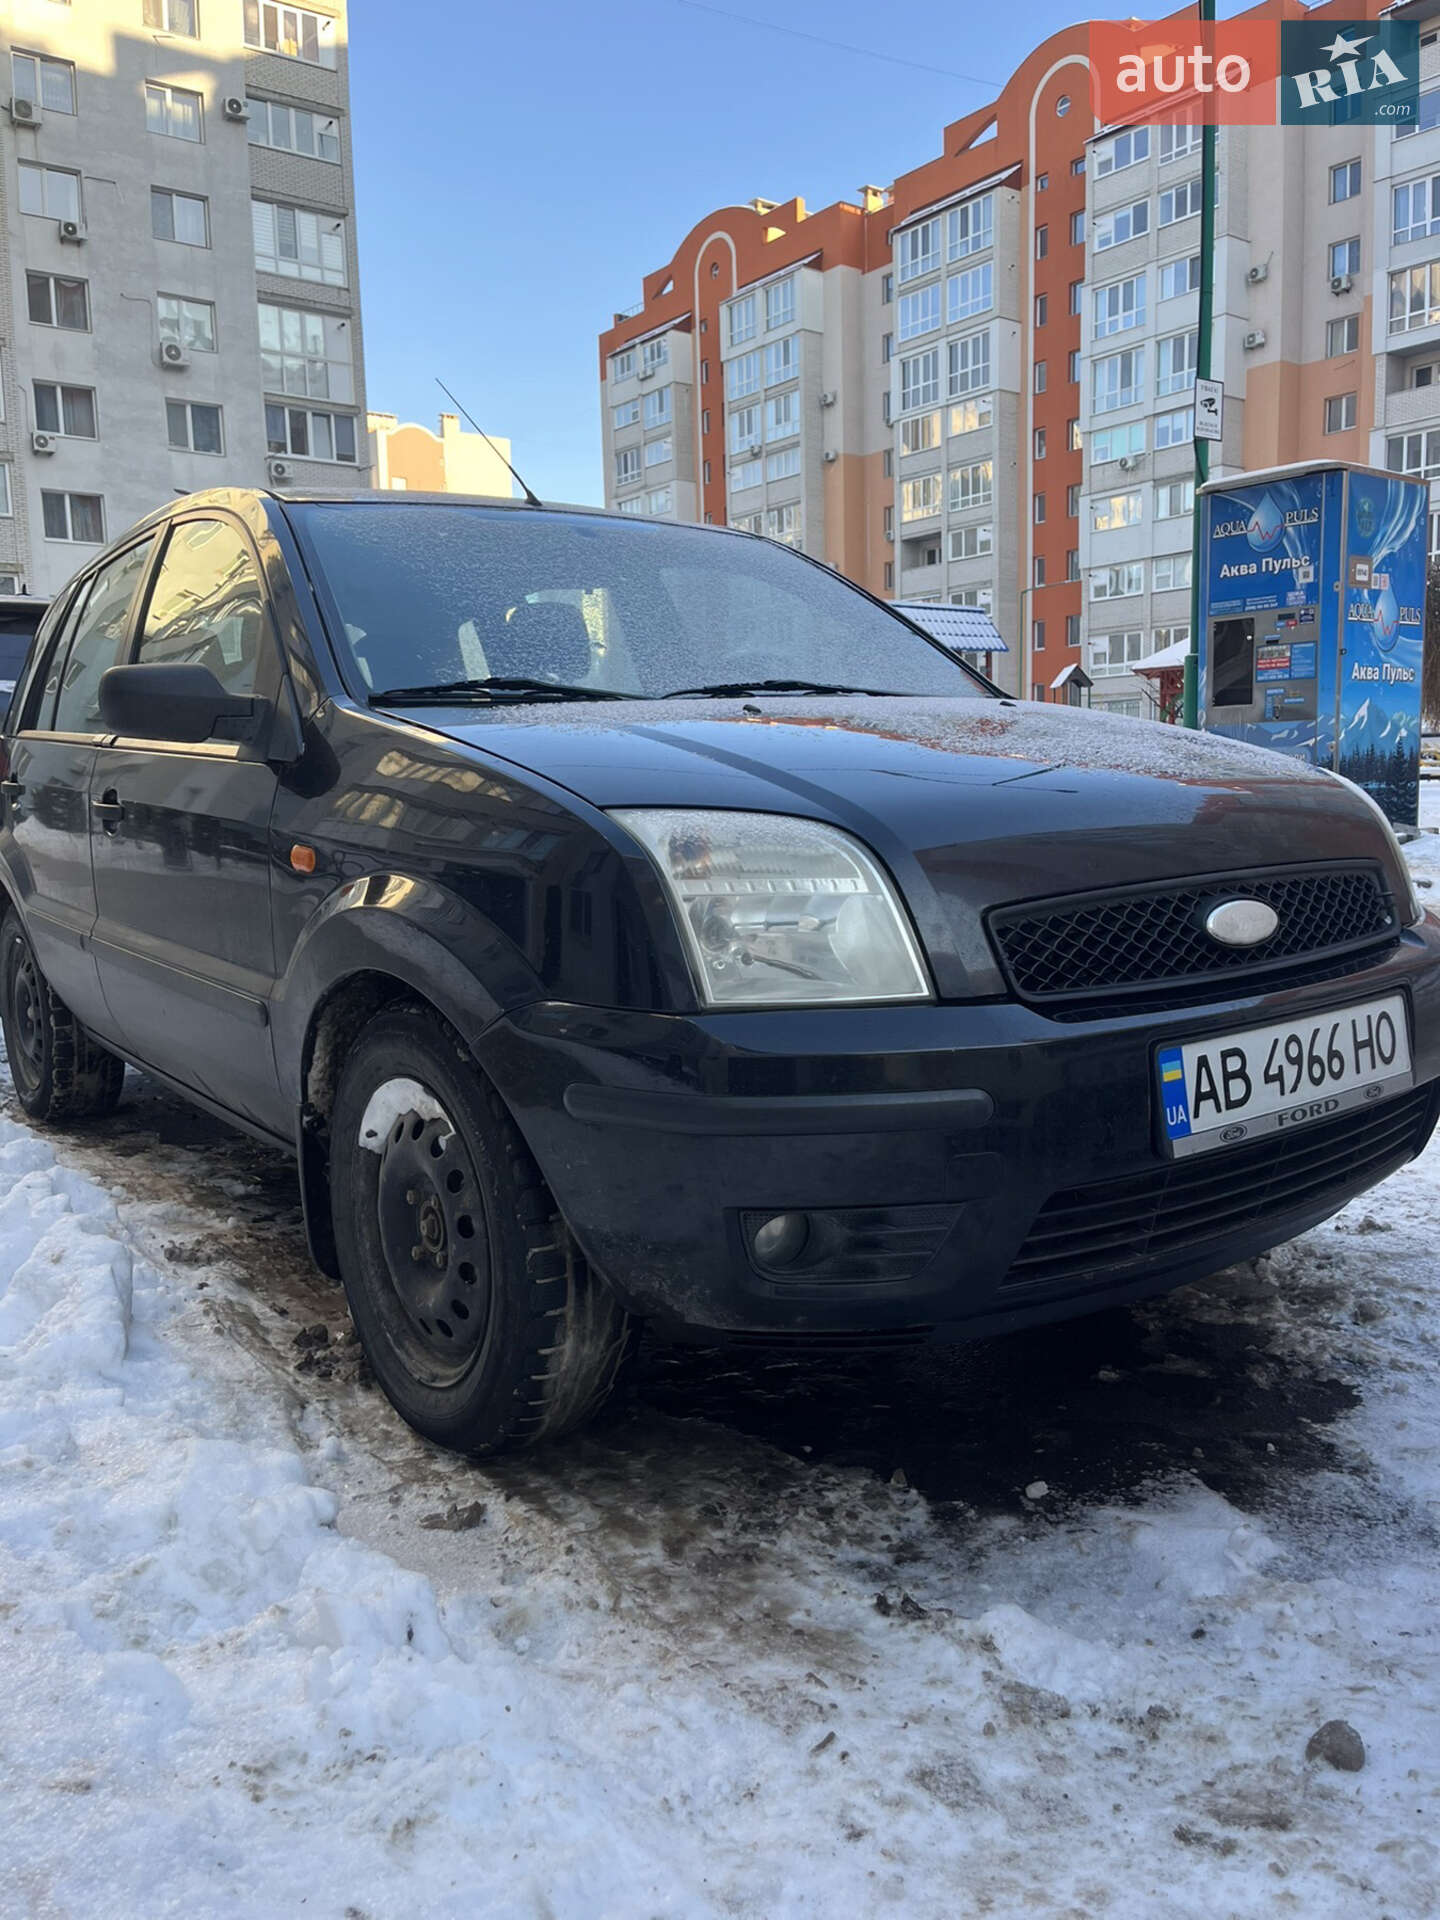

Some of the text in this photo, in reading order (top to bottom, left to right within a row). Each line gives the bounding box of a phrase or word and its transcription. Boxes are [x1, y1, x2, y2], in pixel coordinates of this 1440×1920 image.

[1213, 507, 1319, 538] AQUA PULS
[1220, 555, 1310, 579] Аква Пульс
[1349, 602, 1421, 623] AQUA PULS
[1352, 662, 1415, 685] Аква Пульс
[1193, 1010, 1396, 1119] AB 4966 HO
[1166, 1106, 1188, 1126] UA
[1277, 1099, 1340, 1127] FORD
